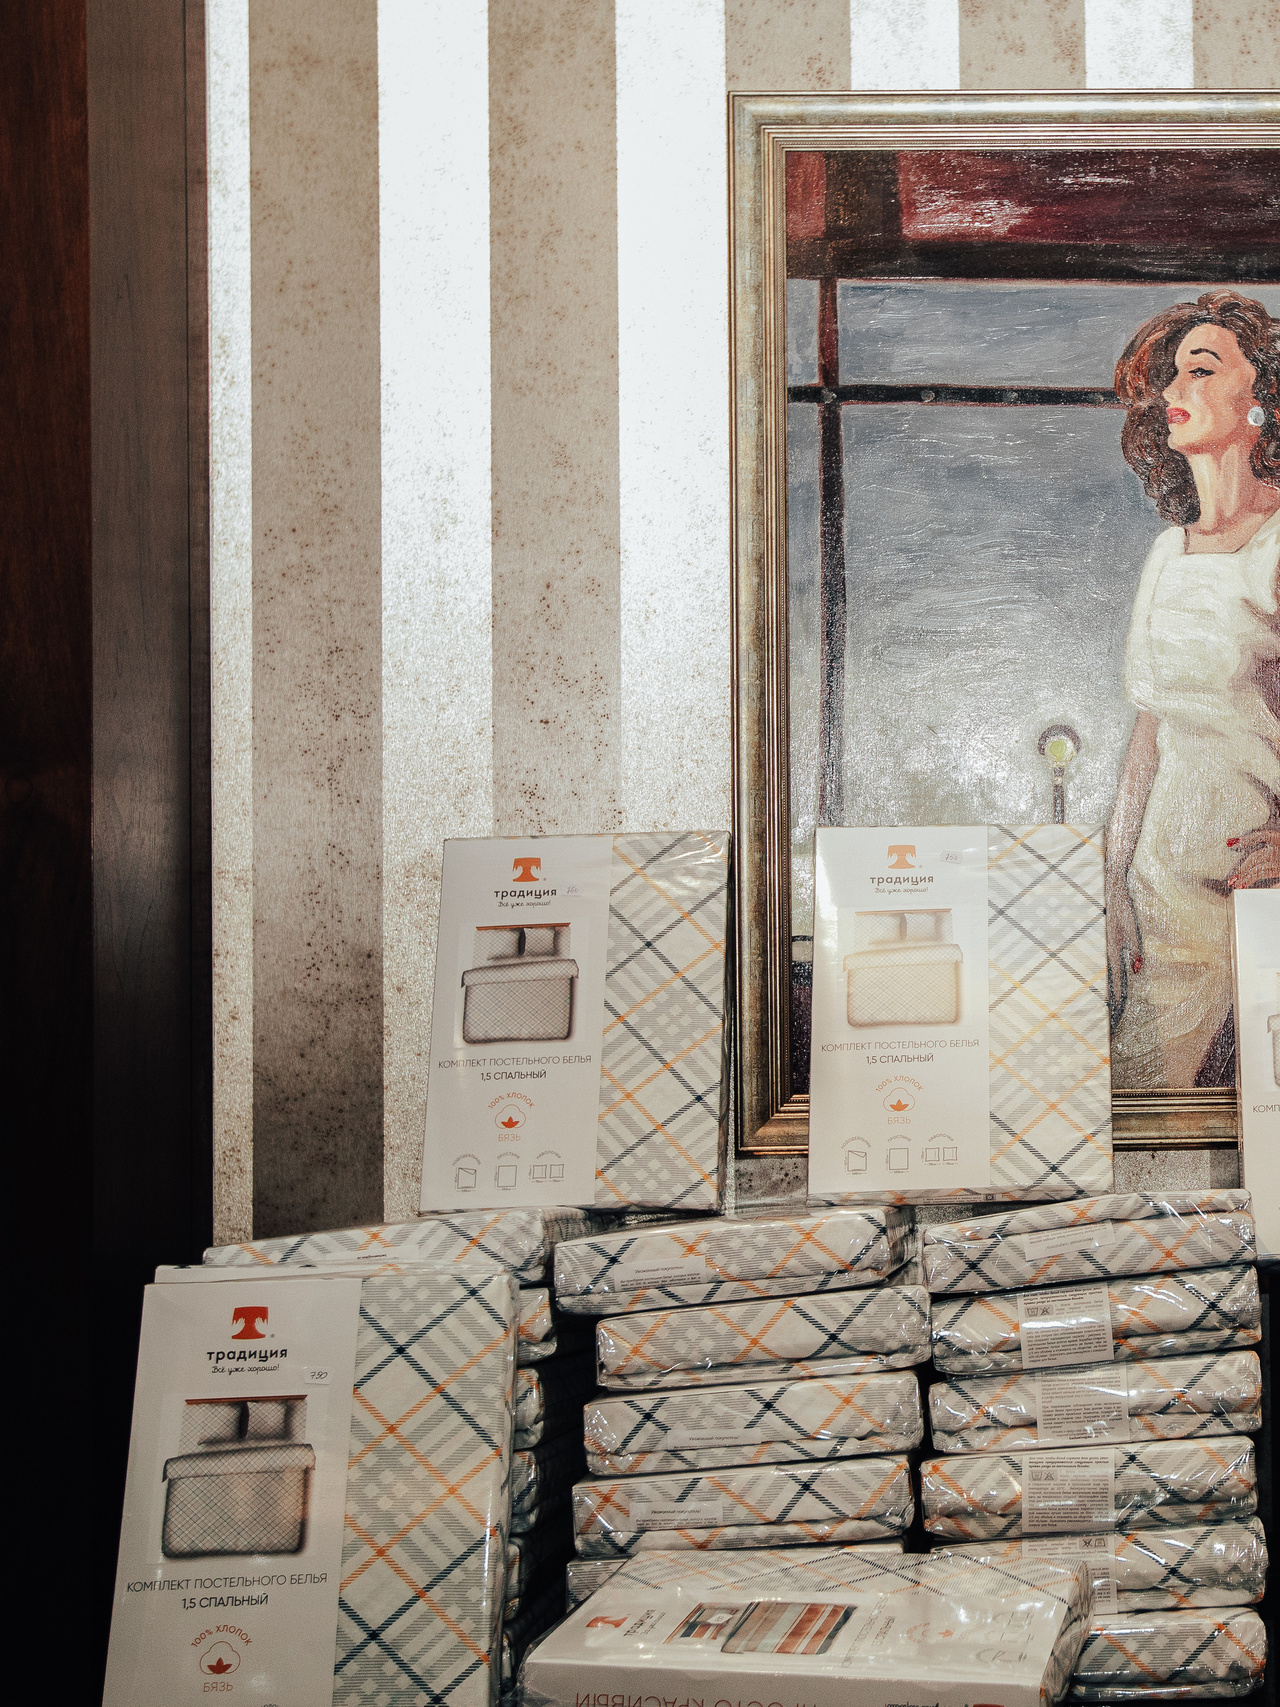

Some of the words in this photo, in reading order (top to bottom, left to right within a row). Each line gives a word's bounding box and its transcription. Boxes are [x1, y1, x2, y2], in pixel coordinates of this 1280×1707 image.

[870, 876, 934, 886] традиция
[494, 889, 557, 900] традиция
[903, 886, 929, 894] хорошо!
[525, 900, 551, 908] хорошо!
[821, 1042, 872, 1052] КОМПЛЕКТ
[874, 1039, 947, 1050] ПОСТЕЛЬНОГО
[949, 1039, 980, 1048] БЕЛЬЯ
[438, 1058, 487, 1069] КОМПЛЕКТ
[489, 1056, 560, 1067] ПОСТЕЛЬНОГО
[562, 1055, 592, 1064] БЕЛЬЯ
[866, 1055, 878, 1065] 1,5
[879, 1052, 934, 1064] СПАЛЬНЫЙ
[480, 1072, 492, 1082] 1,5
[494, 1069, 547, 1080] СПАЛЬНЫЙ
[875, 1078, 892, 1092] 100%
[893, 1075, 924, 1091] ХЛОПОК
[488, 1095, 504, 1109] 100%
[506, 1092, 535, 1108] ХЛОПОК
[887, 1116, 912, 1125] БЯЗЬ
[497, 1133, 521, 1142] БЯЗЬ
[207, 1348, 288, 1364] традиция
[228, 1367, 245, 1375] уже
[247, 1364, 280, 1375] хорошо!
[310, 1371, 328, 1380] 750
[126, 1579, 191, 1592] КОМПЛЕКТ
[194, 1574, 287, 1590] ПОСТЕЛЬНОГО
[290, 1572, 328, 1585] БЕЛЬЯ
[181, 1598, 197, 1611] 1,5
[199, 1592, 269, 1609] СПАЛЬНЫЙ
[190, 1628, 214, 1649] 100%
[215, 1624, 253, 1646] ХЛОПОК
[203, 1682, 234, 1693] БЯЗЬ
